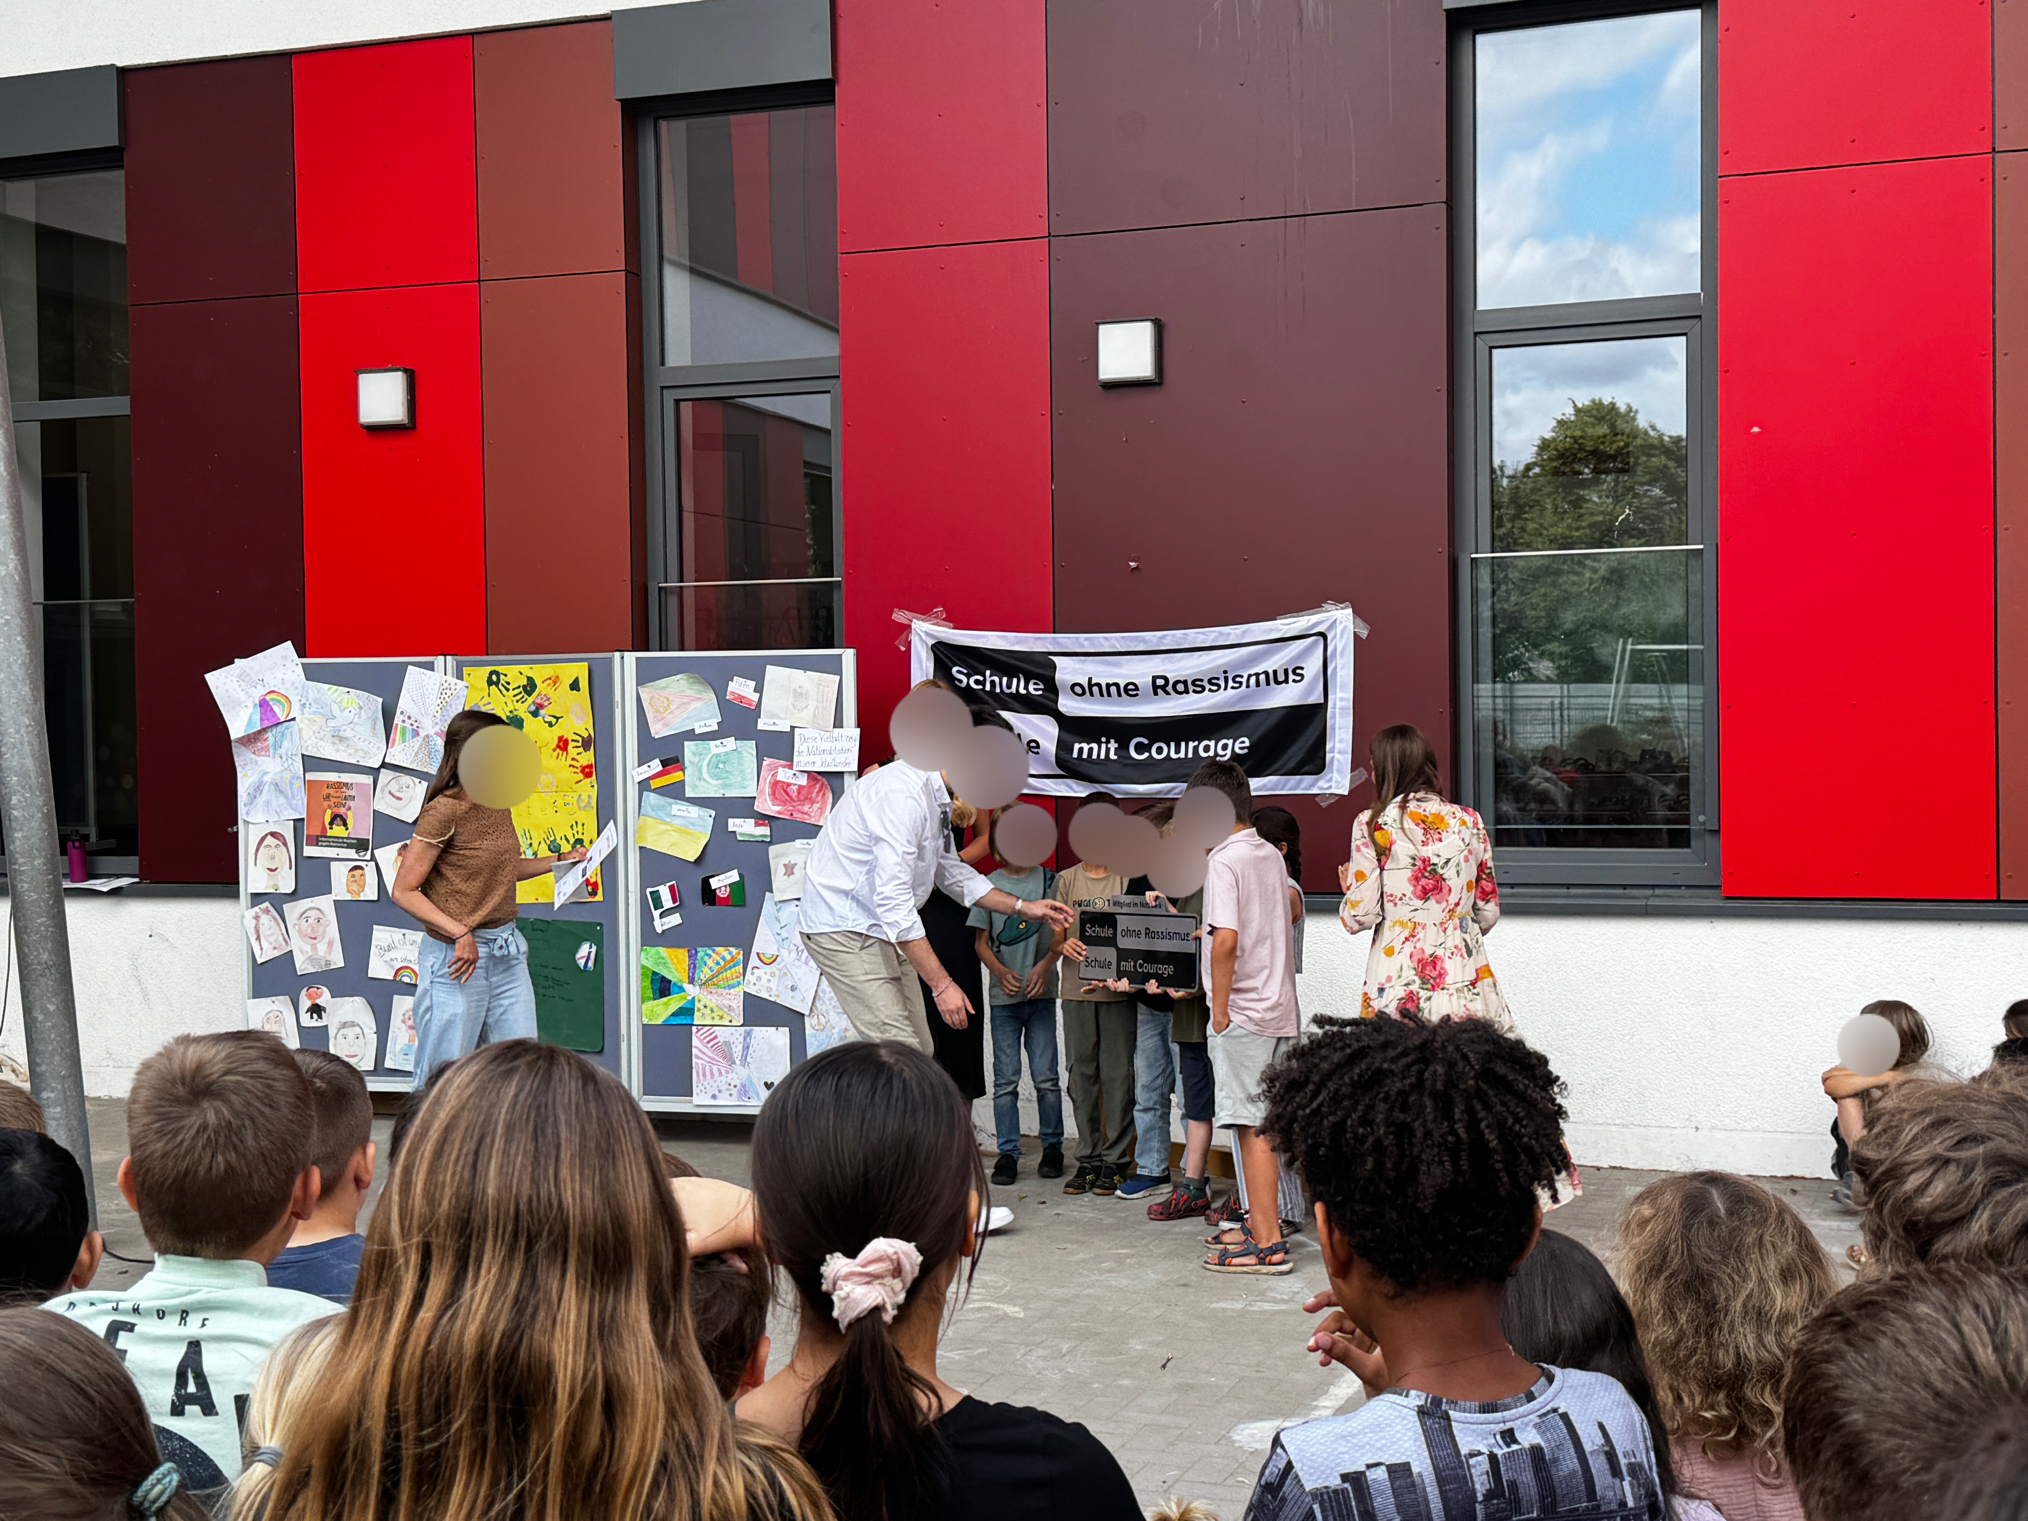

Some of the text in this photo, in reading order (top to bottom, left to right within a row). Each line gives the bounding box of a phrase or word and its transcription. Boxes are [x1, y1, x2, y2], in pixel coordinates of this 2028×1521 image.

[951, 665, 1306, 698] Schule ohne Rassismus
[1072, 736, 1250, 762] mit Courage
[1085, 924, 1191, 942] Schule ohne Rassismus
[1084, 955, 1175, 978] Schule mit Courage
